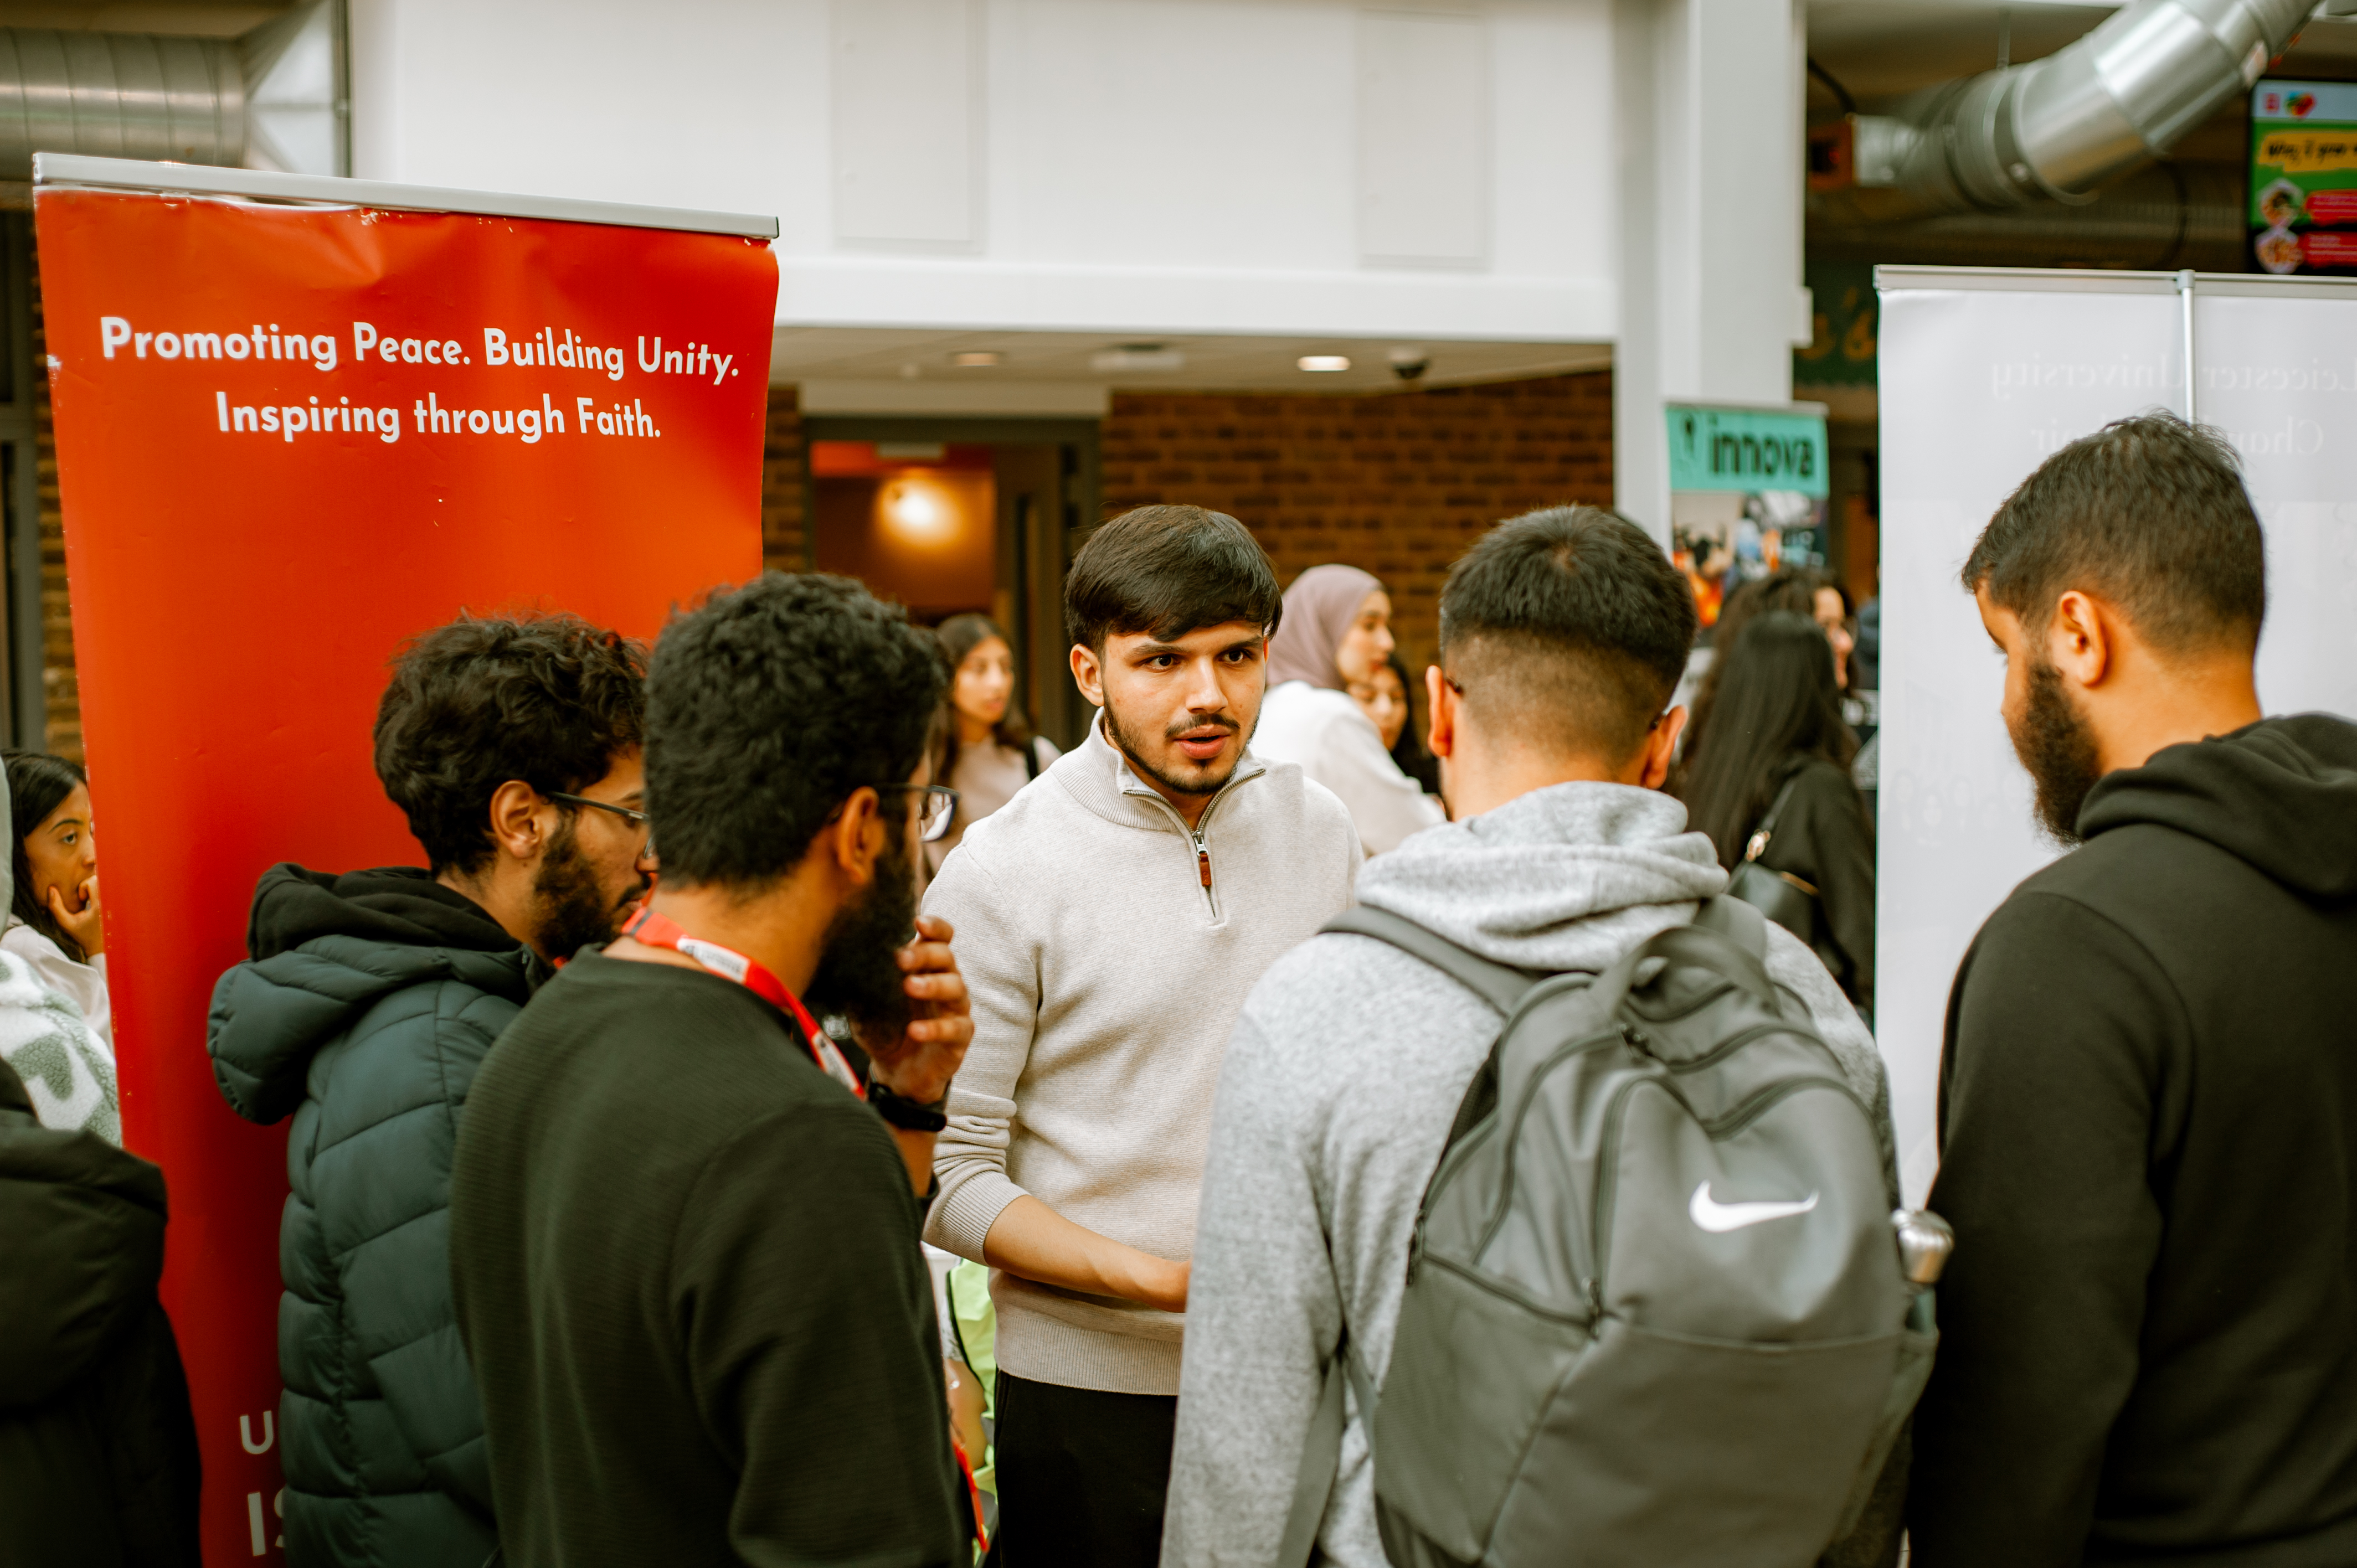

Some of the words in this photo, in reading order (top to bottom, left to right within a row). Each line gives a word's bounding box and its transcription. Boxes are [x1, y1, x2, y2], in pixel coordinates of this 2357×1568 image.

[100, 316, 338, 372] Promoting
[353, 321, 471, 365] Peace.
[483, 326, 625, 381] Building
[637, 335, 739, 386] Unity.
[215, 390, 401, 444] Inspiring
[413, 391, 565, 445] through
[576, 396, 661, 438] Faith.
